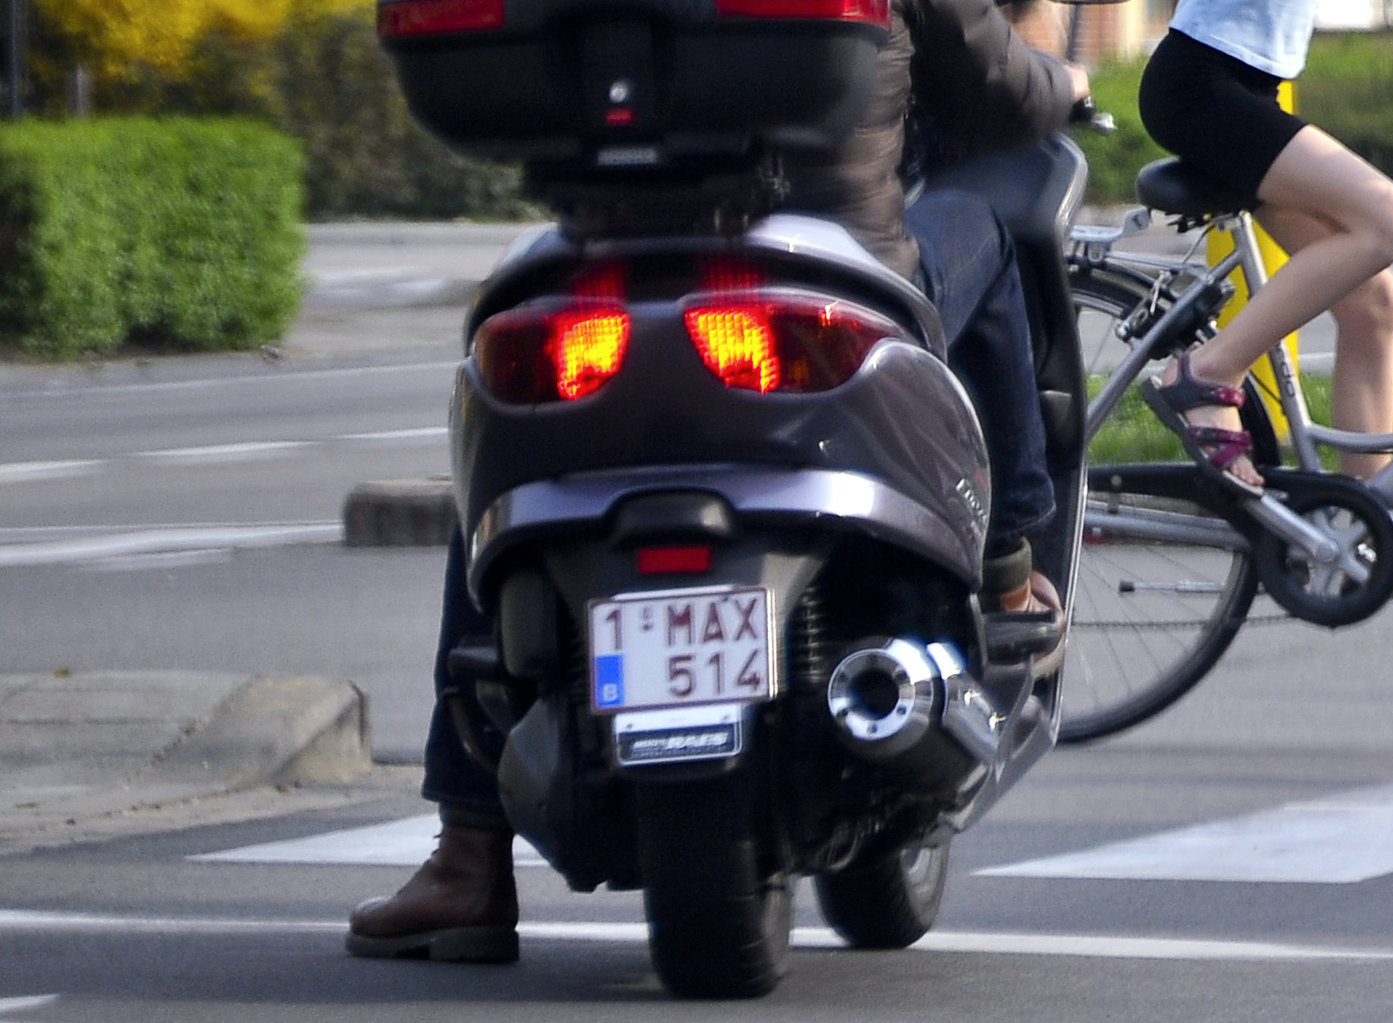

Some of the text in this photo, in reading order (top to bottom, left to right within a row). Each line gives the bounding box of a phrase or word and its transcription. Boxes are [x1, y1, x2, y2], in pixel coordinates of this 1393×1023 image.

[667, 598, 759, 647] MAX
[602, 683, 618, 702] B
[668, 649, 761, 697] 514
